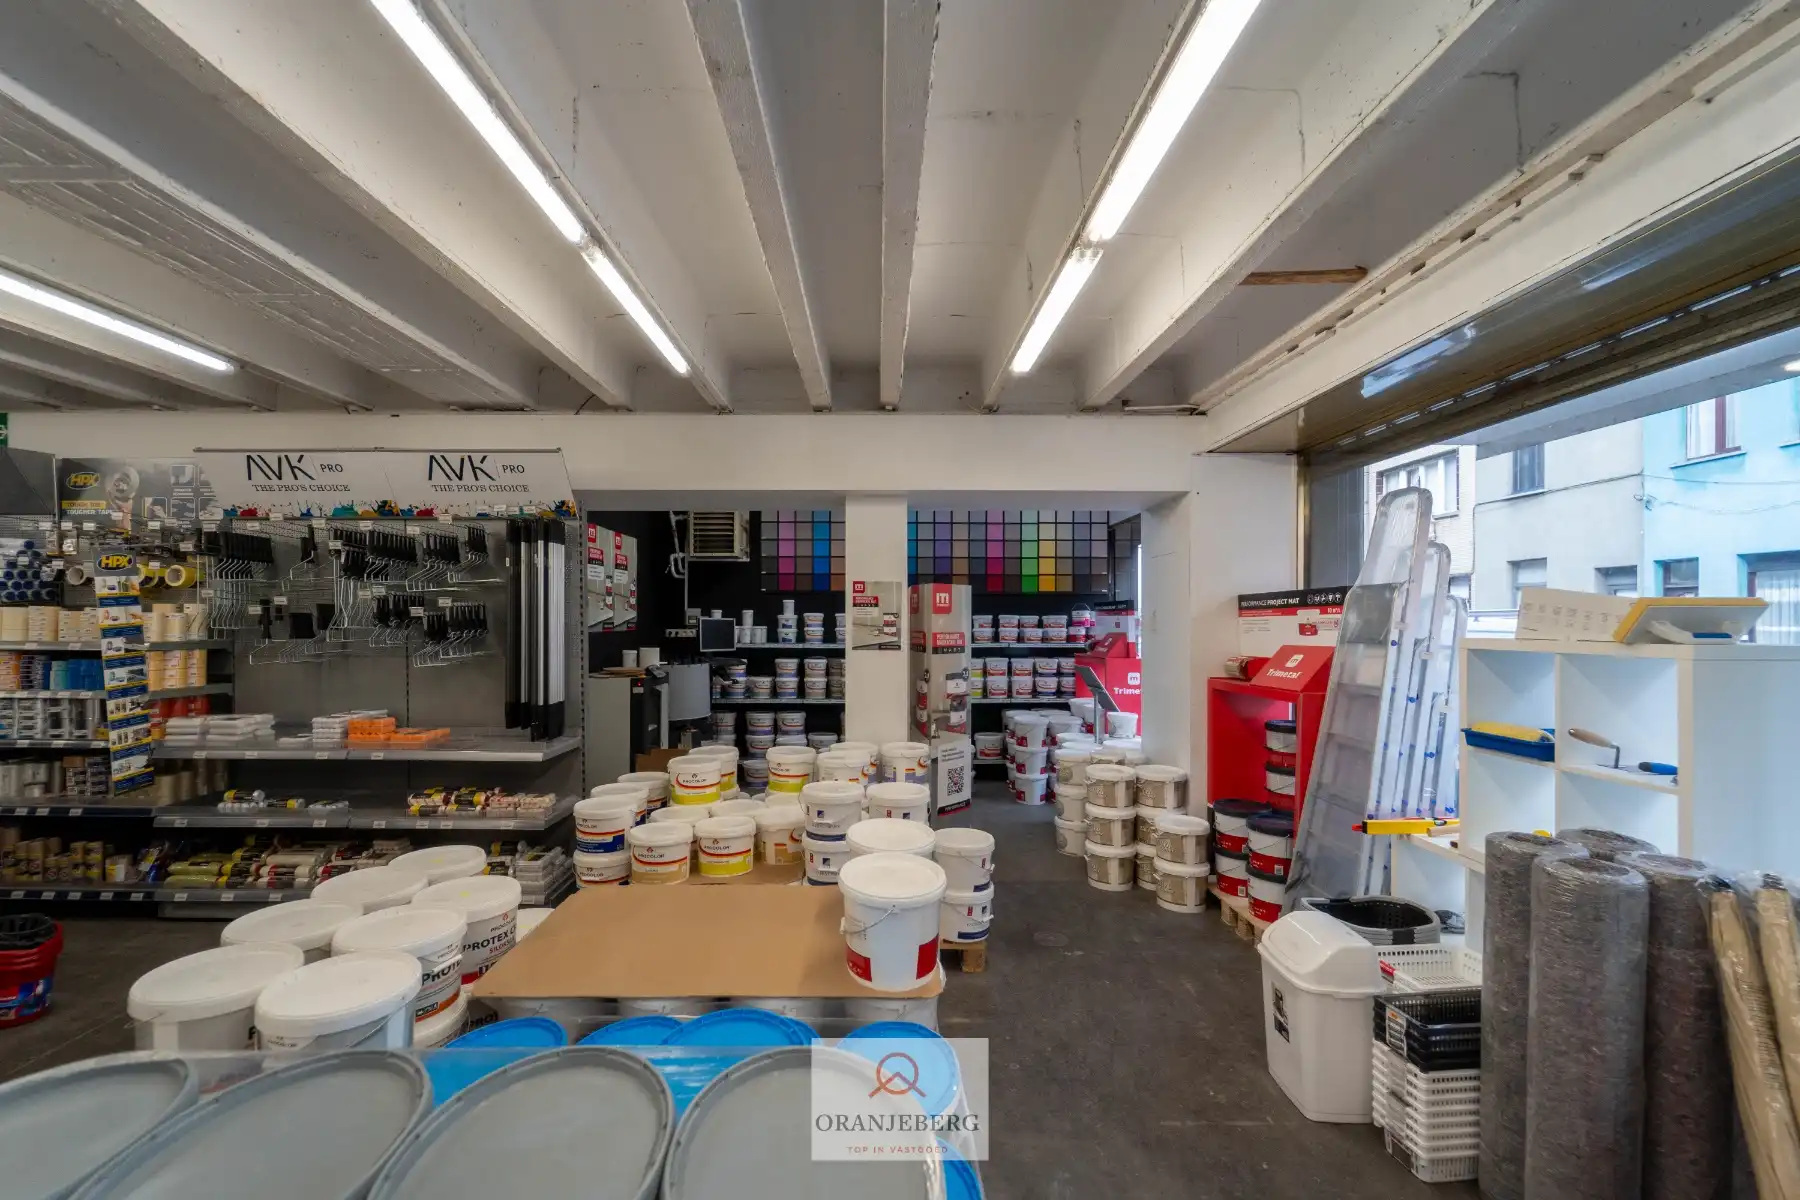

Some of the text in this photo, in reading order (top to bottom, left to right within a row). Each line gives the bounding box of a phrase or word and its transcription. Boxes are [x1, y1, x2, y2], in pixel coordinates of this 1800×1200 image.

[320, 463, 343, 473] PRO
[501, 464, 525, 474] PRO
[69, 473, 100, 487] HPX
[252, 484, 351, 492] THE PRO'S CHOICE
[432, 484, 529, 492] THE PRO'S CHOICE
[101, 553, 129, 569] HPX
[1267, 598, 1288, 606] PROJECT
[1267, 668, 1303, 679] Trimetal
[463, 930, 509, 953] PROTEX
